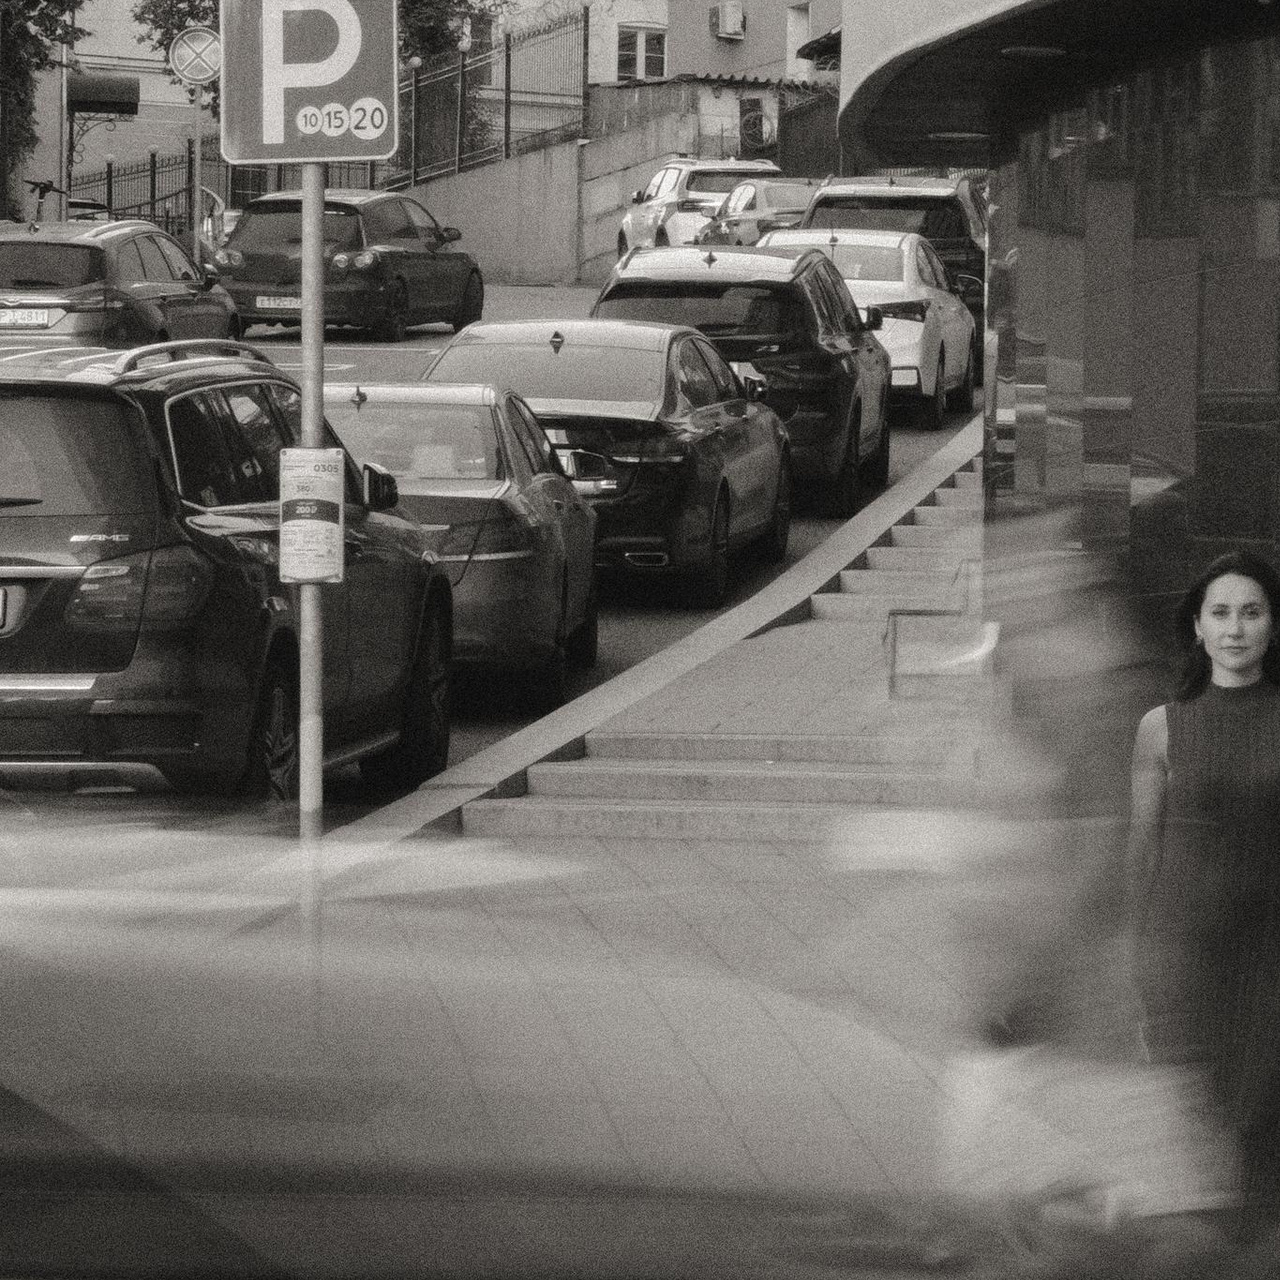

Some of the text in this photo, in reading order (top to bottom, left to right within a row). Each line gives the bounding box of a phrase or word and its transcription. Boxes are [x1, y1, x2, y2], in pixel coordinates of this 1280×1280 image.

[302, 106, 384, 131] 10 15 20
